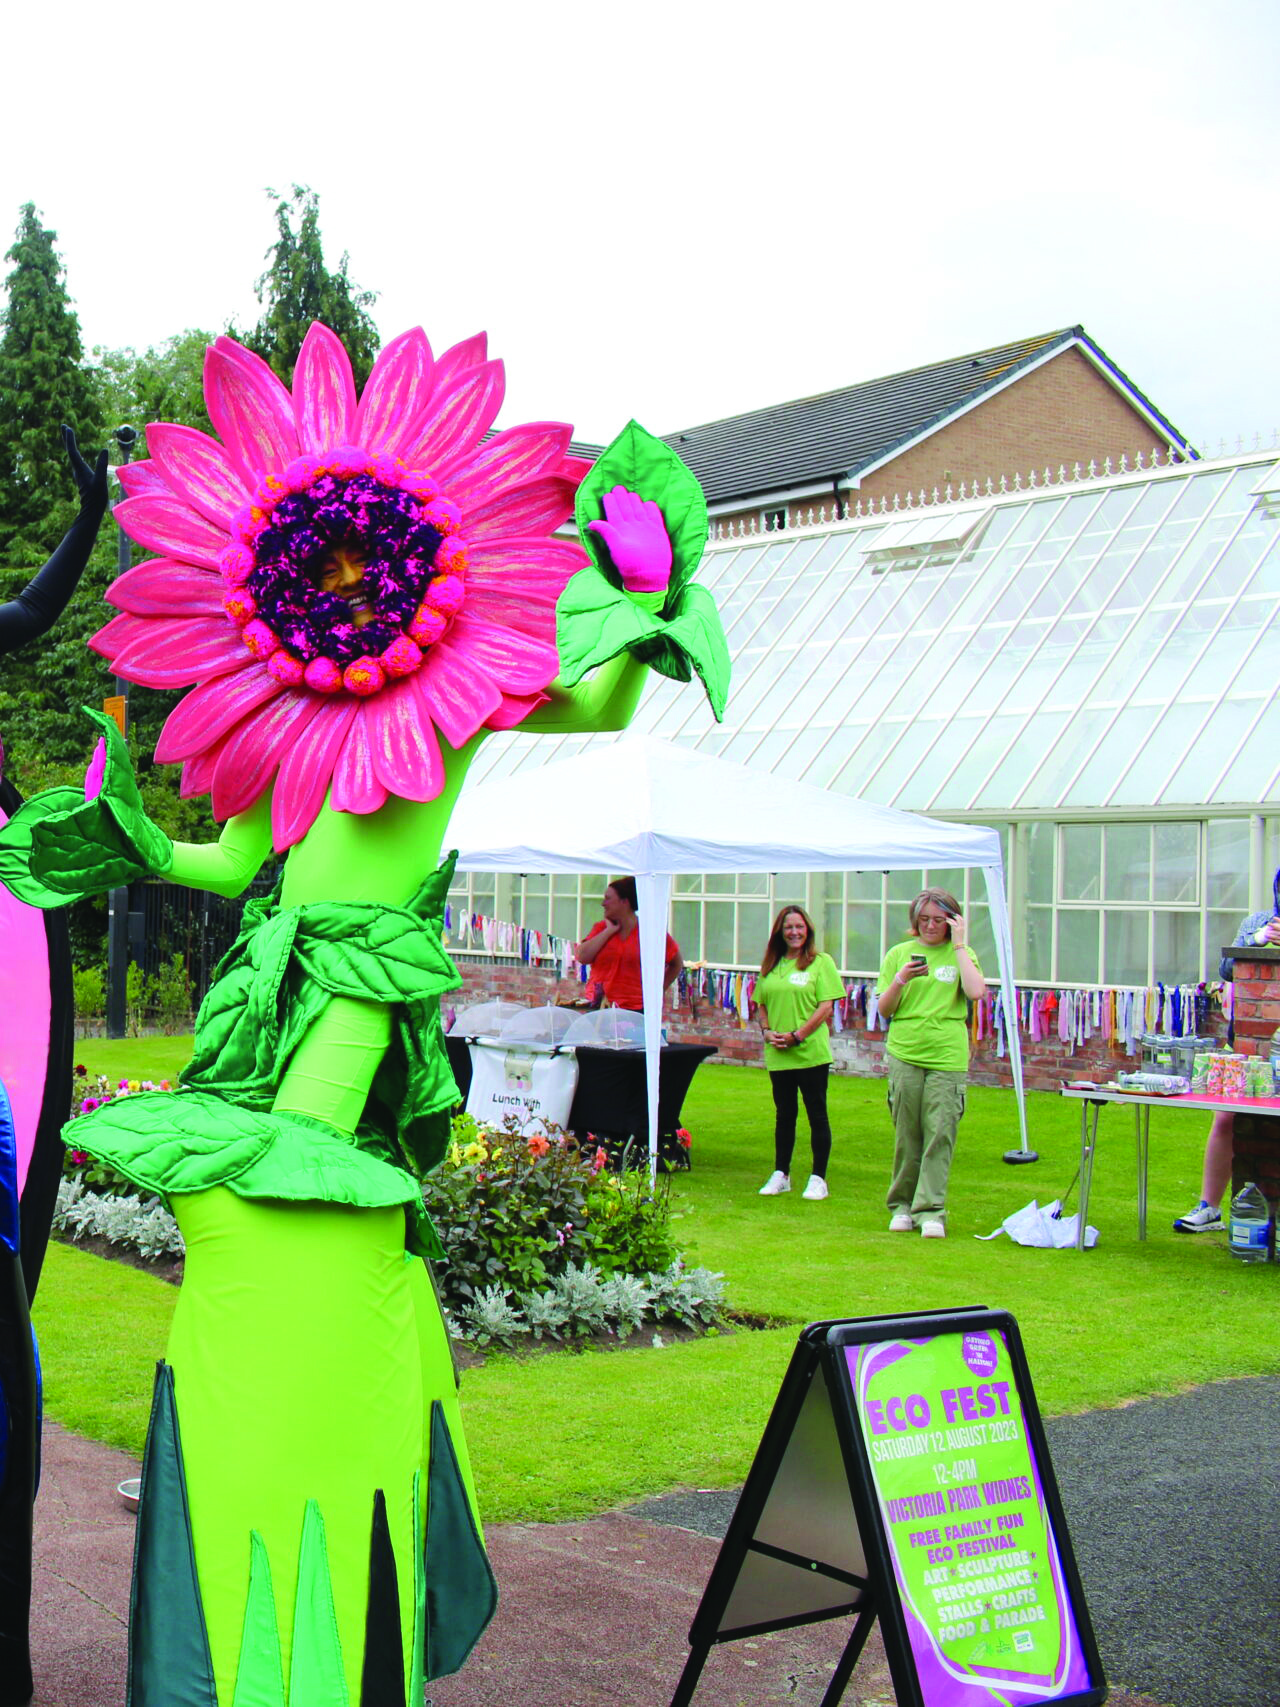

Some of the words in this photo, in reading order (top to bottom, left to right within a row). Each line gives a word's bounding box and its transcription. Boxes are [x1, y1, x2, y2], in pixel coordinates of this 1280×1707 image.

[492, 1093, 520, 1106] Lunch
[865, 1394, 930, 1435] ECO
[940, 1381, 1011, 1423] FEST
[872, 1434, 930, 1462] SATURDAY
[930, 1431, 946, 1452] 12
[946, 1424, 987, 1450] AUGUST
[989, 1420, 1019, 1443] 2023
[933, 1458, 977, 1484] 12-4PM
[887, 1491, 946, 1523] VICTORIA
[947, 1485, 982, 1512] PARK
[982, 1475, 1032, 1505] WIDNES
[909, 1528, 942, 1548] FREE
[945, 1519, 992, 1541] FAMILY
[996, 1513, 1024, 1531] FUN
[927, 1546, 954, 1564] ECO
[957, 1534, 1016, 1558] FESTIVAL
[924, 1566, 949, 1586] ART
[957, 1550, 1030, 1578] SCULPTURE
[932, 1569, 1032, 1603] PERFORMANCE
[937, 1599, 985, 1623] STALLS
[992, 1588, 1038, 1610] CRAFTS
[938, 1621, 977, 1644] FOOD
[980, 1617, 991, 1633] &
[994, 1605, 1046, 1630] PARADE
